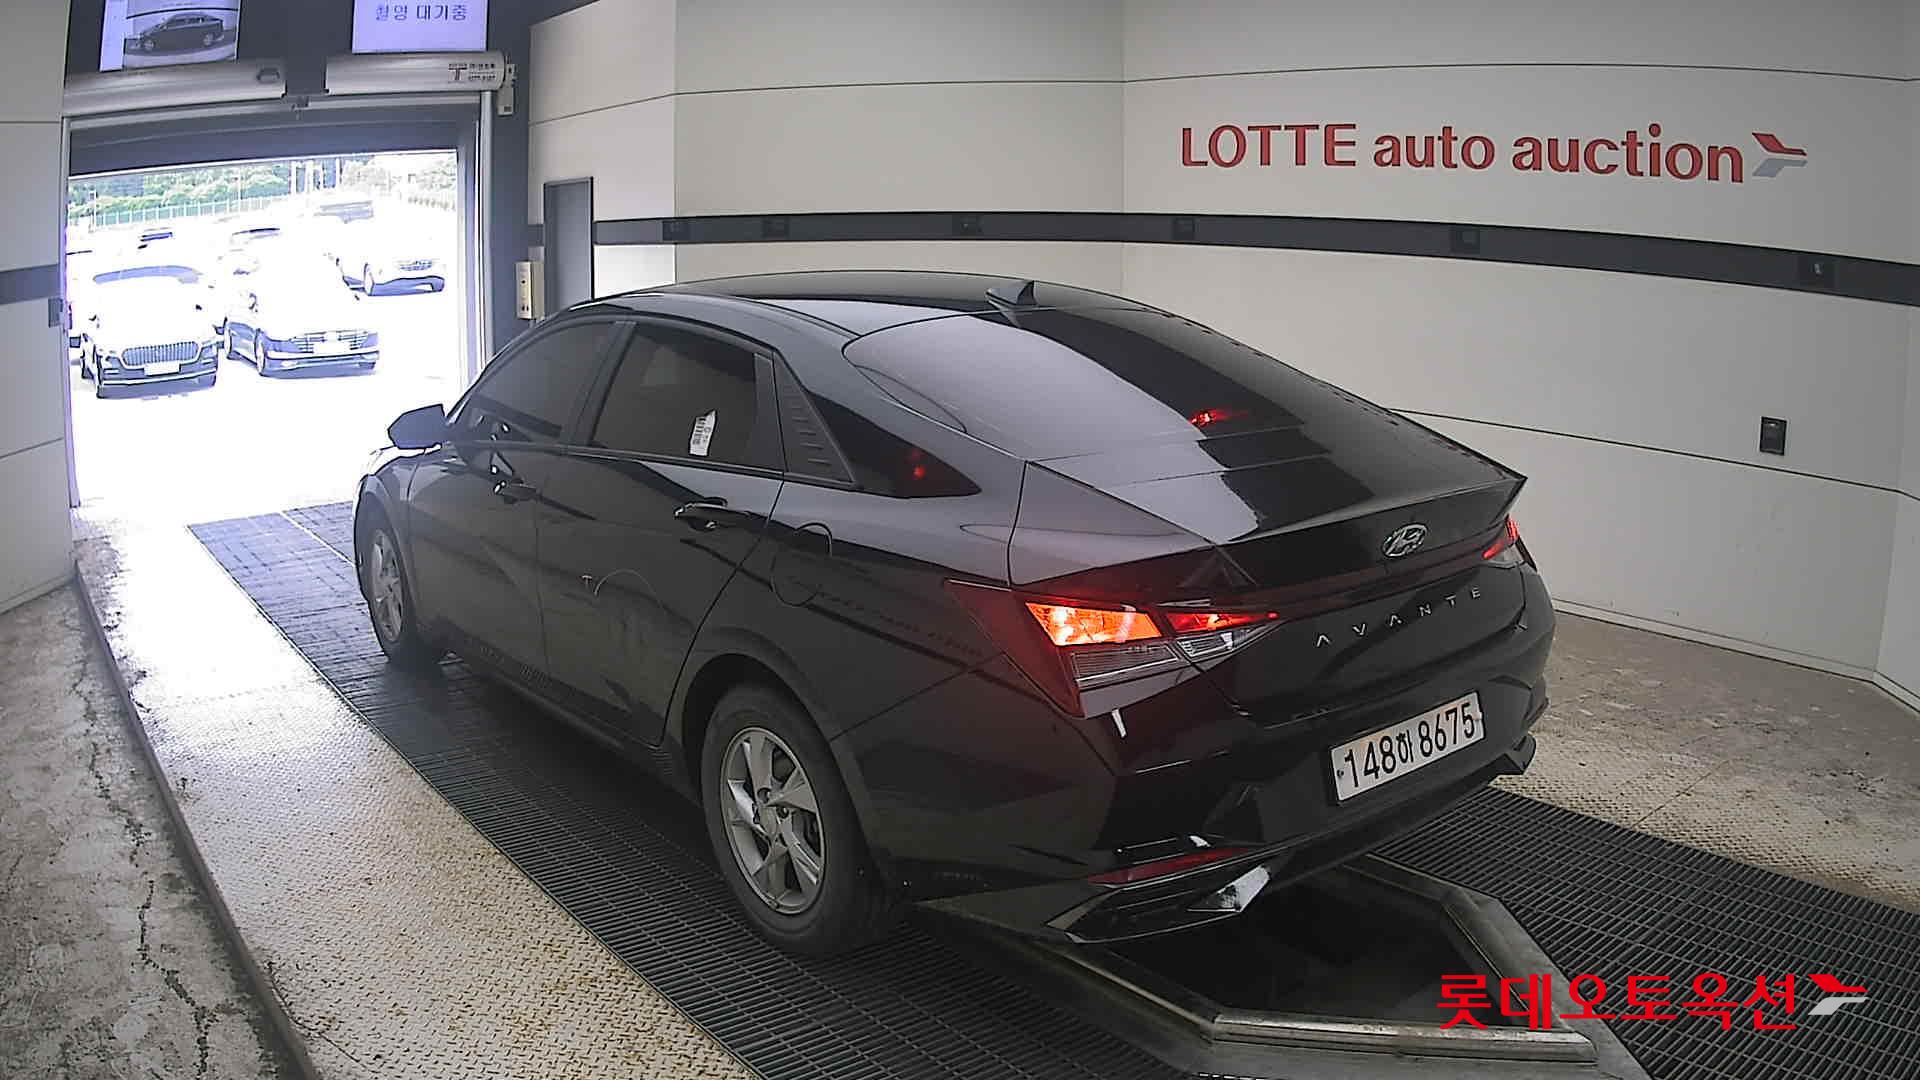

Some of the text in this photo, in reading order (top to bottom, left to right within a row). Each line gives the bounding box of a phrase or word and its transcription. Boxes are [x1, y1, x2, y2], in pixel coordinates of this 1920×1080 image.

[416, 4, 467, 21] 대기중
[1181, 122, 1744, 184] LOTTE auto auction
[1315, 586, 1482, 647] AVANTE
[1344, 701, 1475, 788] 148하 8675
